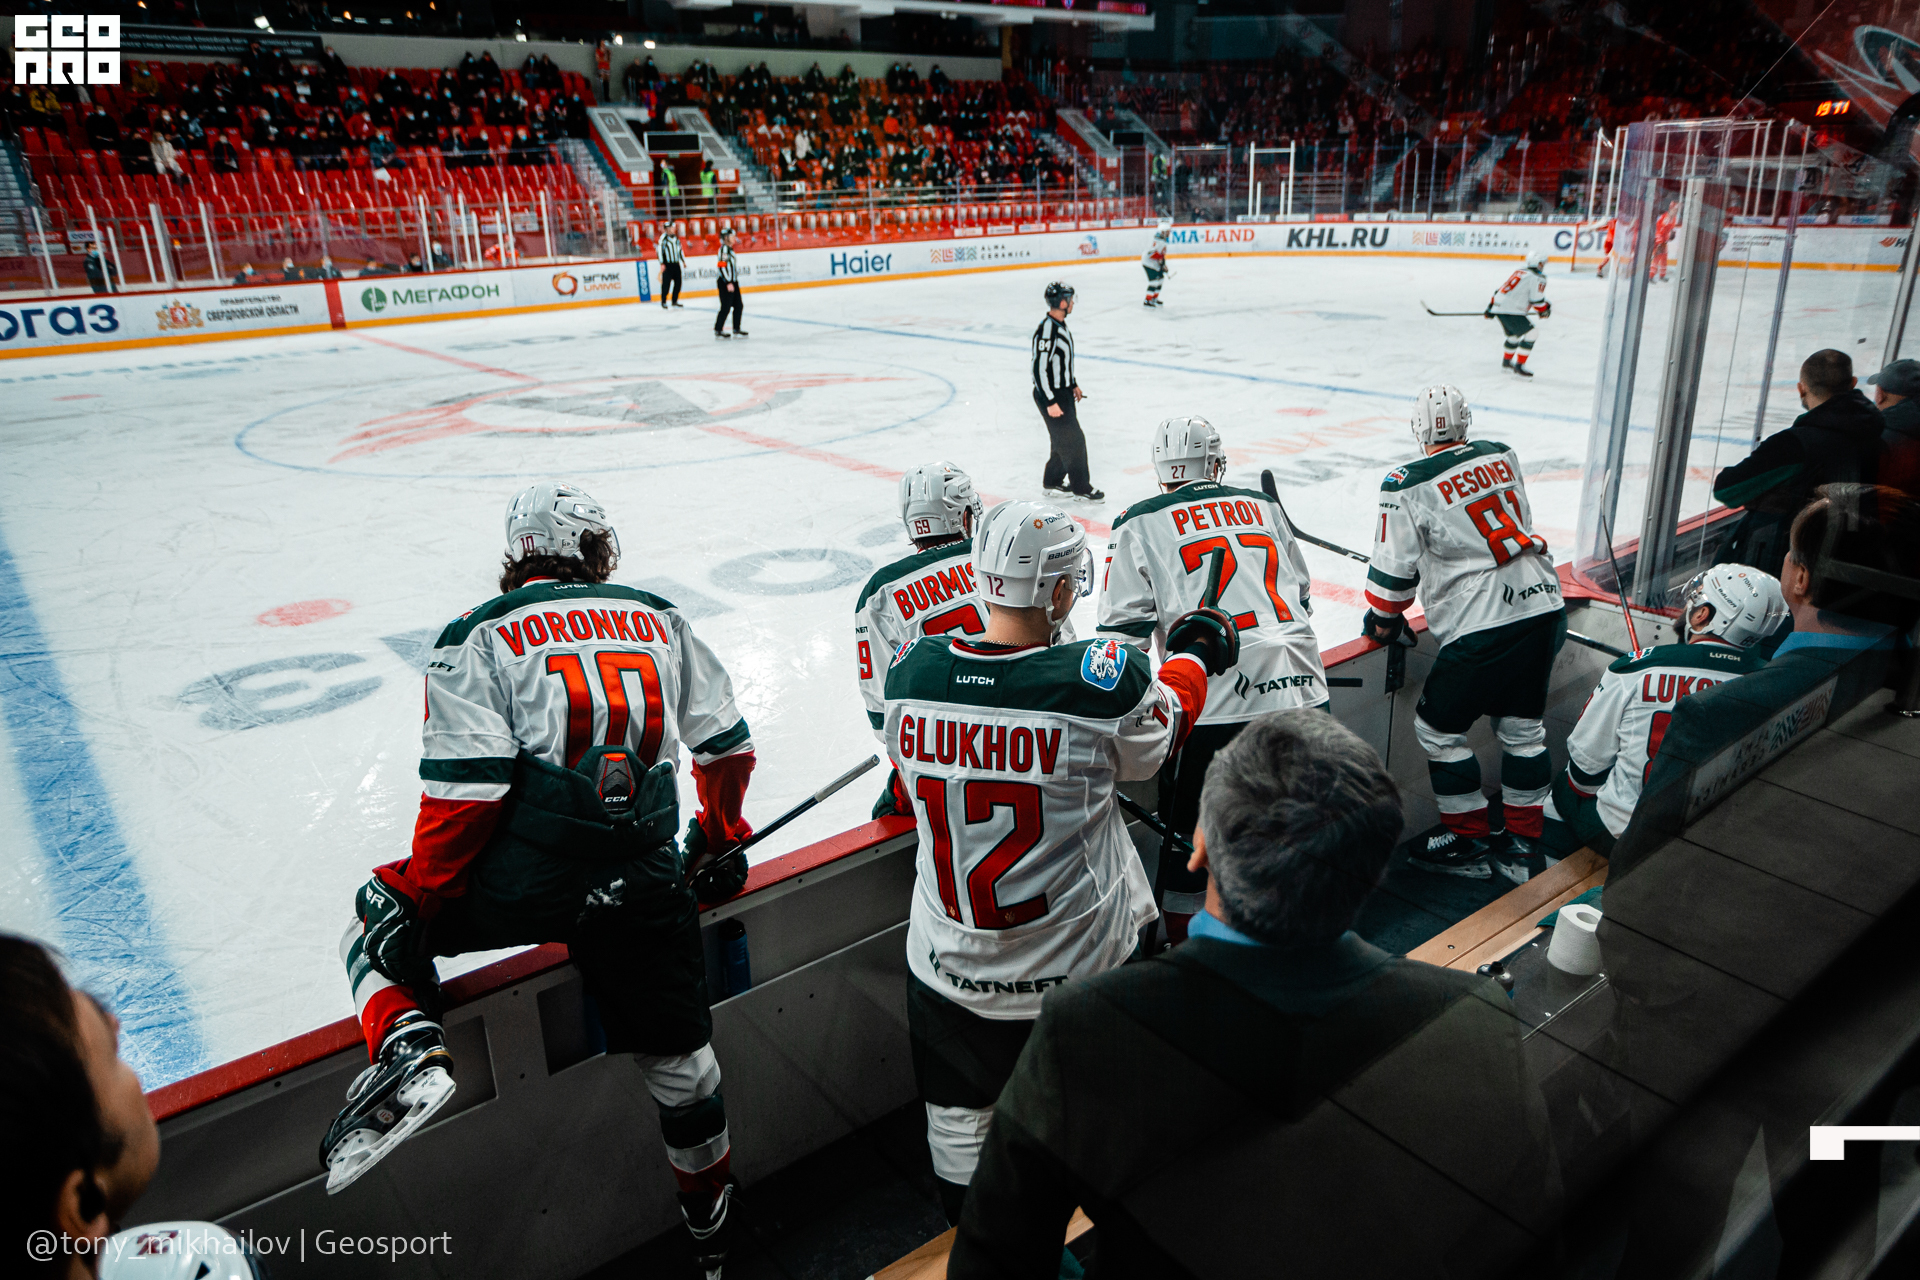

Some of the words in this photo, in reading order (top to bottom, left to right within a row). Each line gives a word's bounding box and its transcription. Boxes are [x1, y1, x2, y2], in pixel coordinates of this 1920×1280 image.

[1286, 227, 1390, 248] KHL.RU
[830, 250, 892, 276] Haier
[582, 272, 621, 283] УГМК
[583, 281, 622, 293] UMMC
[0, 304, 120, 342] огаз
[206, 305, 266, 322] СВЕРДЛОВСКОЙ
[266, 304, 300, 318] ОБЛАСТИ
[1038, 339, 1052, 352] 84
[1436, 417, 1446, 429] 81
[1171, 465, 1186, 479] 27
[1437, 459, 1516, 505] PESONEN
[1379, 502, 1401, 511] NEFT
[914, 519, 931, 535] 69
[1171, 500, 1264, 536] PETROV
[1465, 489, 1535, 567] 81
[520, 535, 535, 555] 10
[986, 575, 1006, 598] 12
[1179, 532, 1295, 632] 27
[496, 608, 669, 657] VORONKOV
[1709, 652, 1741, 662] LUTCH
[956, 674, 995, 686] LUTCH
[1253, 675, 1314, 695] TATNEFT
[545, 650, 665, 770] 10
[899, 713, 1062, 775] GLUKHOV
[604, 795, 629, 803] CCM
[916, 775, 1050, 931] 12
[945, 972, 1069, 994] TATNEFT
